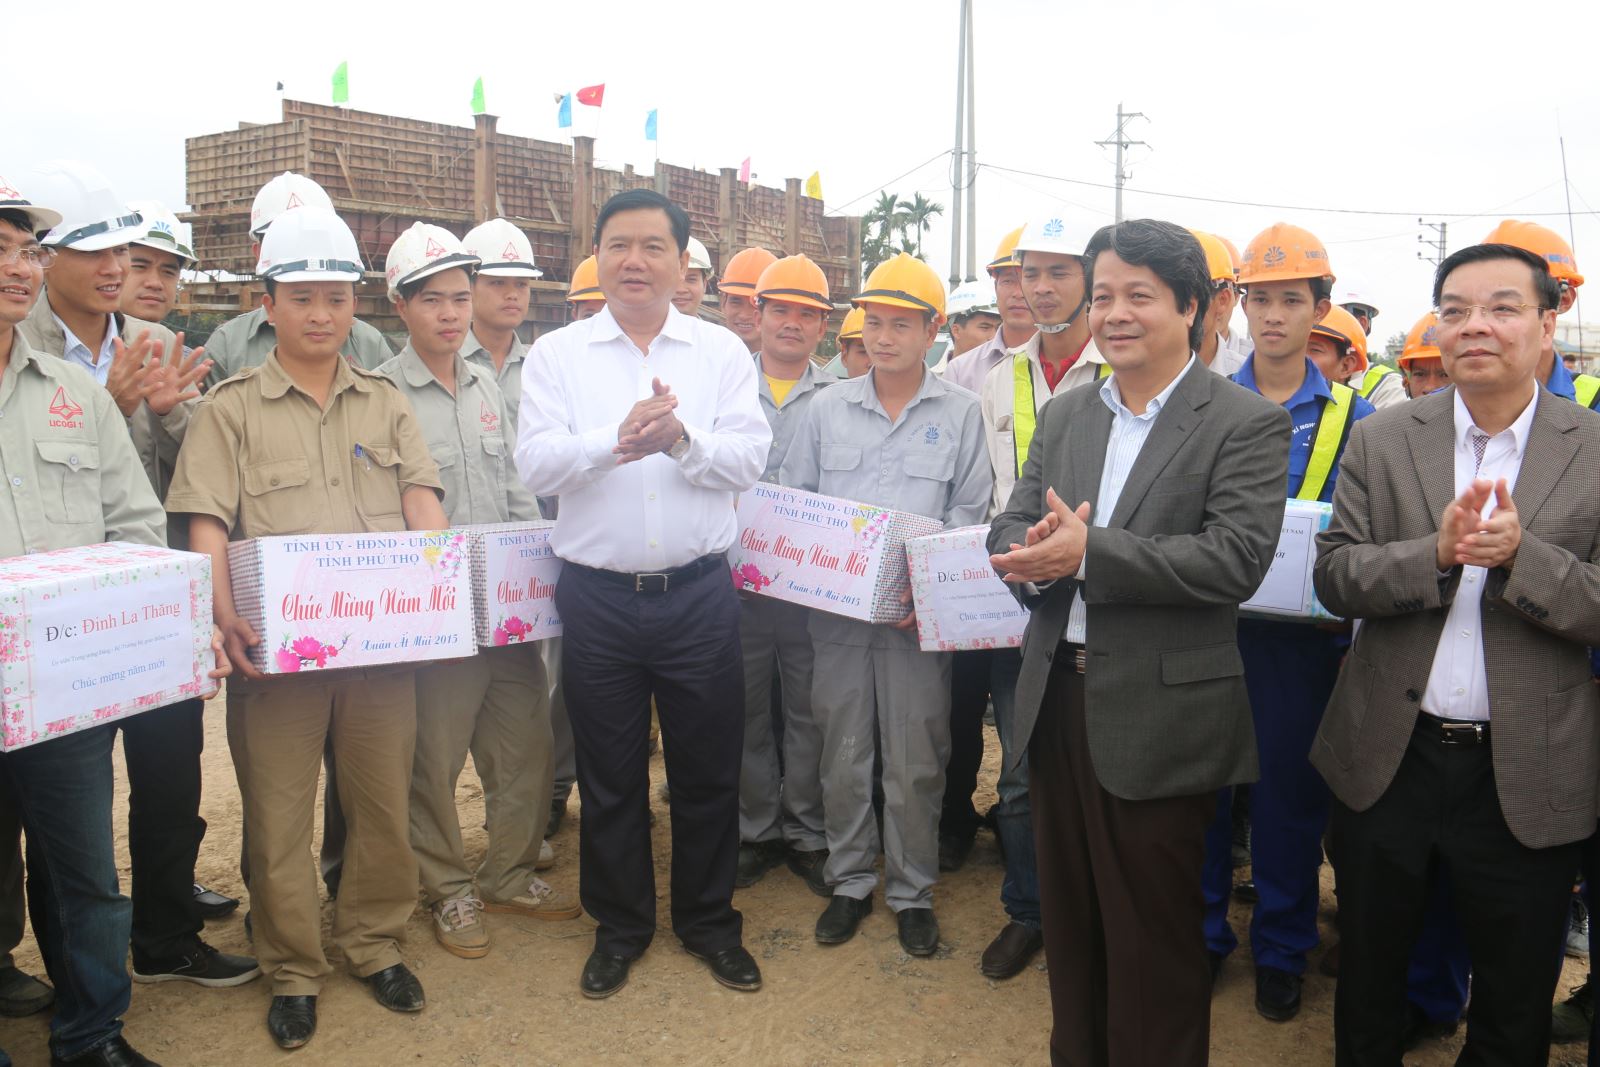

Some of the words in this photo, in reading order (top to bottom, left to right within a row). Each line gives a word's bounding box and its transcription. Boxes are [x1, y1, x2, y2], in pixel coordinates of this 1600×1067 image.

[49, 420, 76, 428] LICOGI
[755, 487, 780, 500] TỈNH
[804, 498, 835, 512] HĐND
[773, 504, 798, 518] TỈNH
[801, 512, 824, 523] PHÚ
[825, 516, 848, 530] THỌ
[284, 539, 320, 552] TỈNH
[356, 539, 398, 550] HĐND
[408, 536, 448, 548] UBND
[498, 534, 522, 546] TỈNH
[519, 546, 542, 558] TỈNH
[740, 527, 768, 553] Chúc
[769, 534, 806, 567] Mừng
[807, 542, 840, 571] Năm
[842, 550, 869, 577] Mới
[316, 554, 352, 567] TỈNH
[356, 554, 387, 566] PHÚ
[389, 553, 420, 566] THỌ
[963, 567, 989, 580] Đinh
[497, 580, 524, 605] Chúc
[281, 594, 323, 622] Chúc
[326, 590, 375, 622] Mừng
[379, 587, 421, 615] Năm
[425, 585, 457, 612] Mới
[840, 594, 860, 606] 2015
[45, 624, 77, 641] Đ/c:
[82, 614, 117, 634] Đinh
[122, 611, 138, 625] La
[142, 603, 181, 621] Thăng
[959, 611, 979, 623] Chúc
[434, 633, 459, 645] 2015
[72, 676, 97, 691] Chúc
